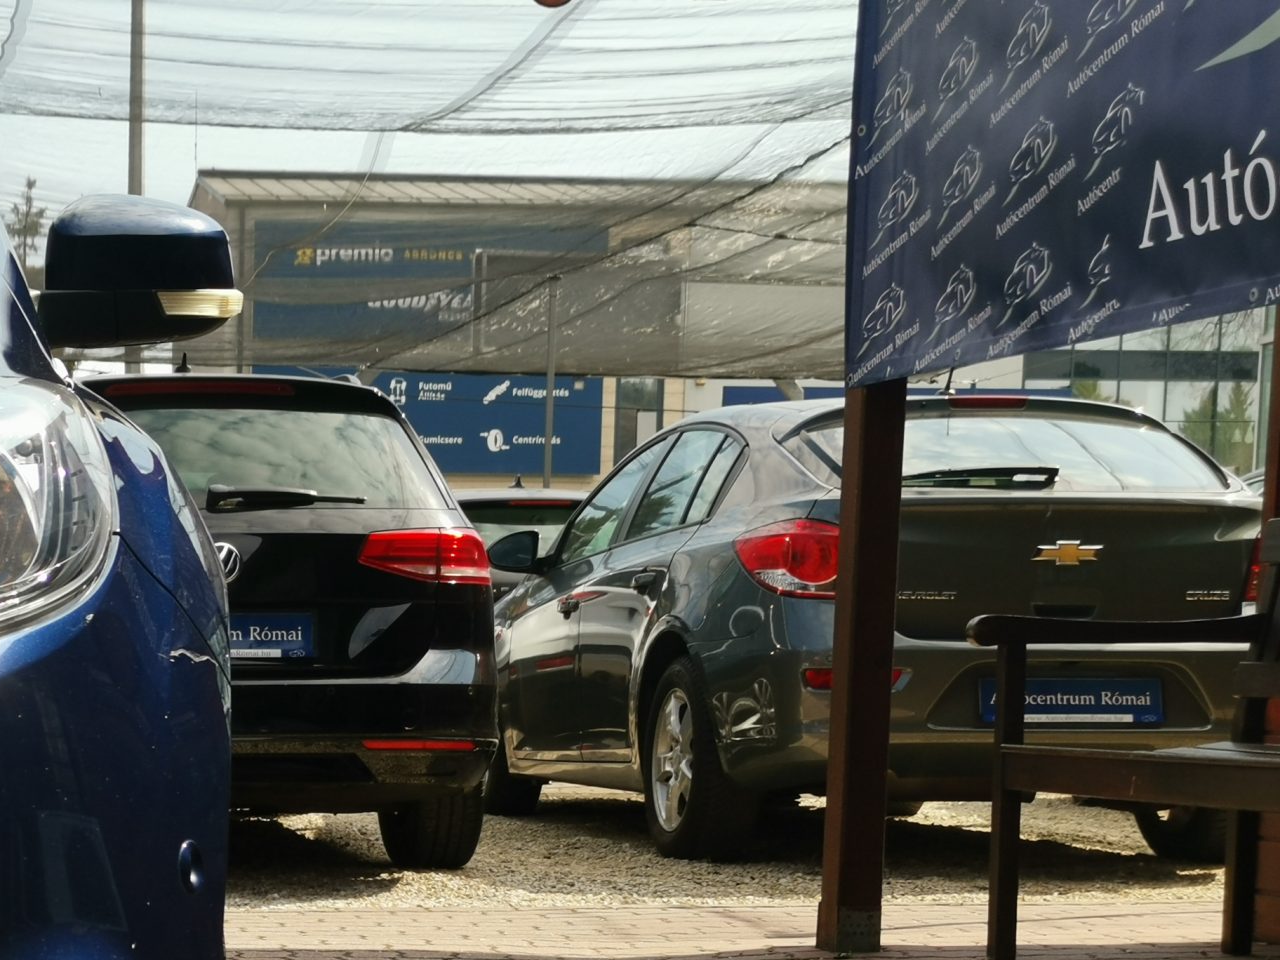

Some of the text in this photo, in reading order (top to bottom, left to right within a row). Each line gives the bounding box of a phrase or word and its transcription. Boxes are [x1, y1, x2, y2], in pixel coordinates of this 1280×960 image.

[989, 35, 1069, 128] Autócentrum Római
[1066, 1, 1166, 98] Autócentrum Római
[929, 180, 997, 261] Autócentrum Római
[995, 152, 1076, 240] Autócentrum Római
[1138, 129, 1277, 250] Autó
[316, 247, 393, 266] premio
[861, 203, 932, 280] Autócentrum Római
[894, 318, 921, 348] Római
[1039, 281, 1073, 317] Római
[913, 302, 992, 374] Autócentrum Római
[249, 626, 303, 641] Római
[1101, 691, 1152, 705] Római
